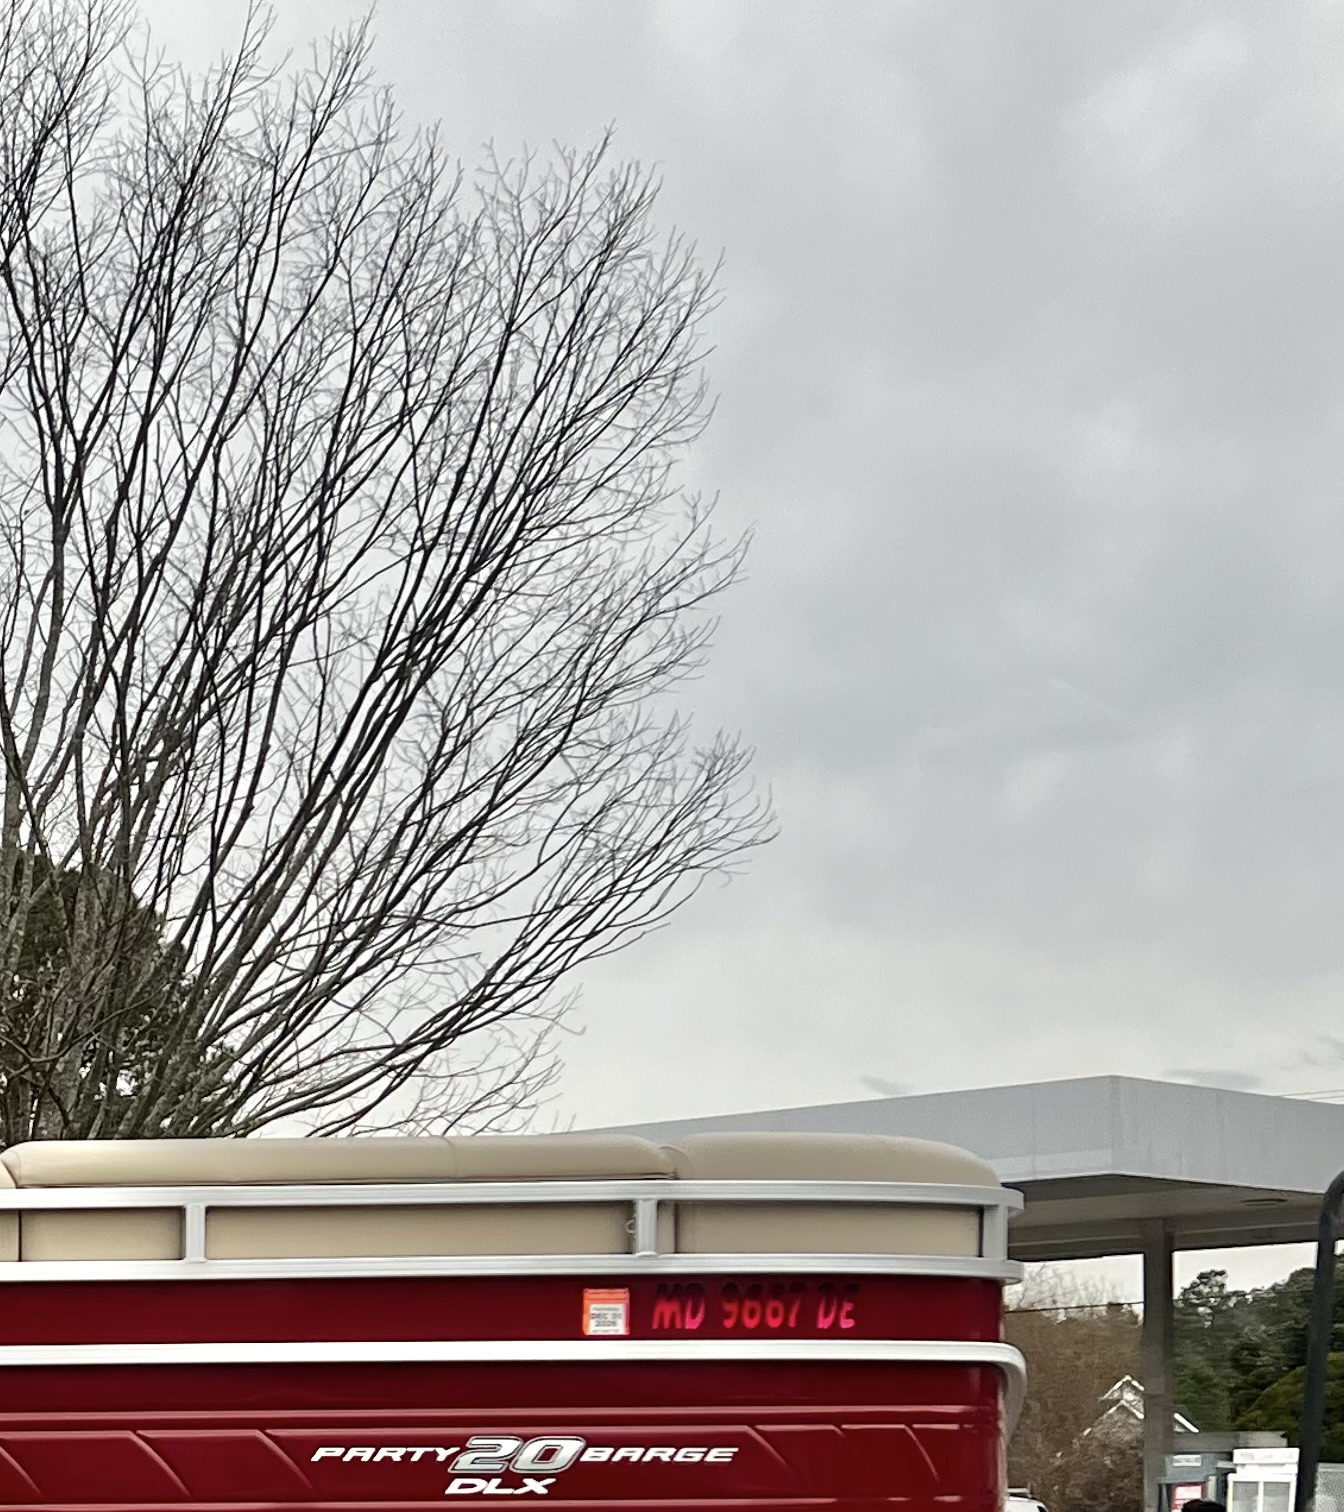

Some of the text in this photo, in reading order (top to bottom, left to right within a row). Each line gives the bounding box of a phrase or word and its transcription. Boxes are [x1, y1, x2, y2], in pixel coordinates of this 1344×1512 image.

[311, 1435, 739, 1475] PARTY 20 BARGE
[444, 1477, 557, 1496] DLX
